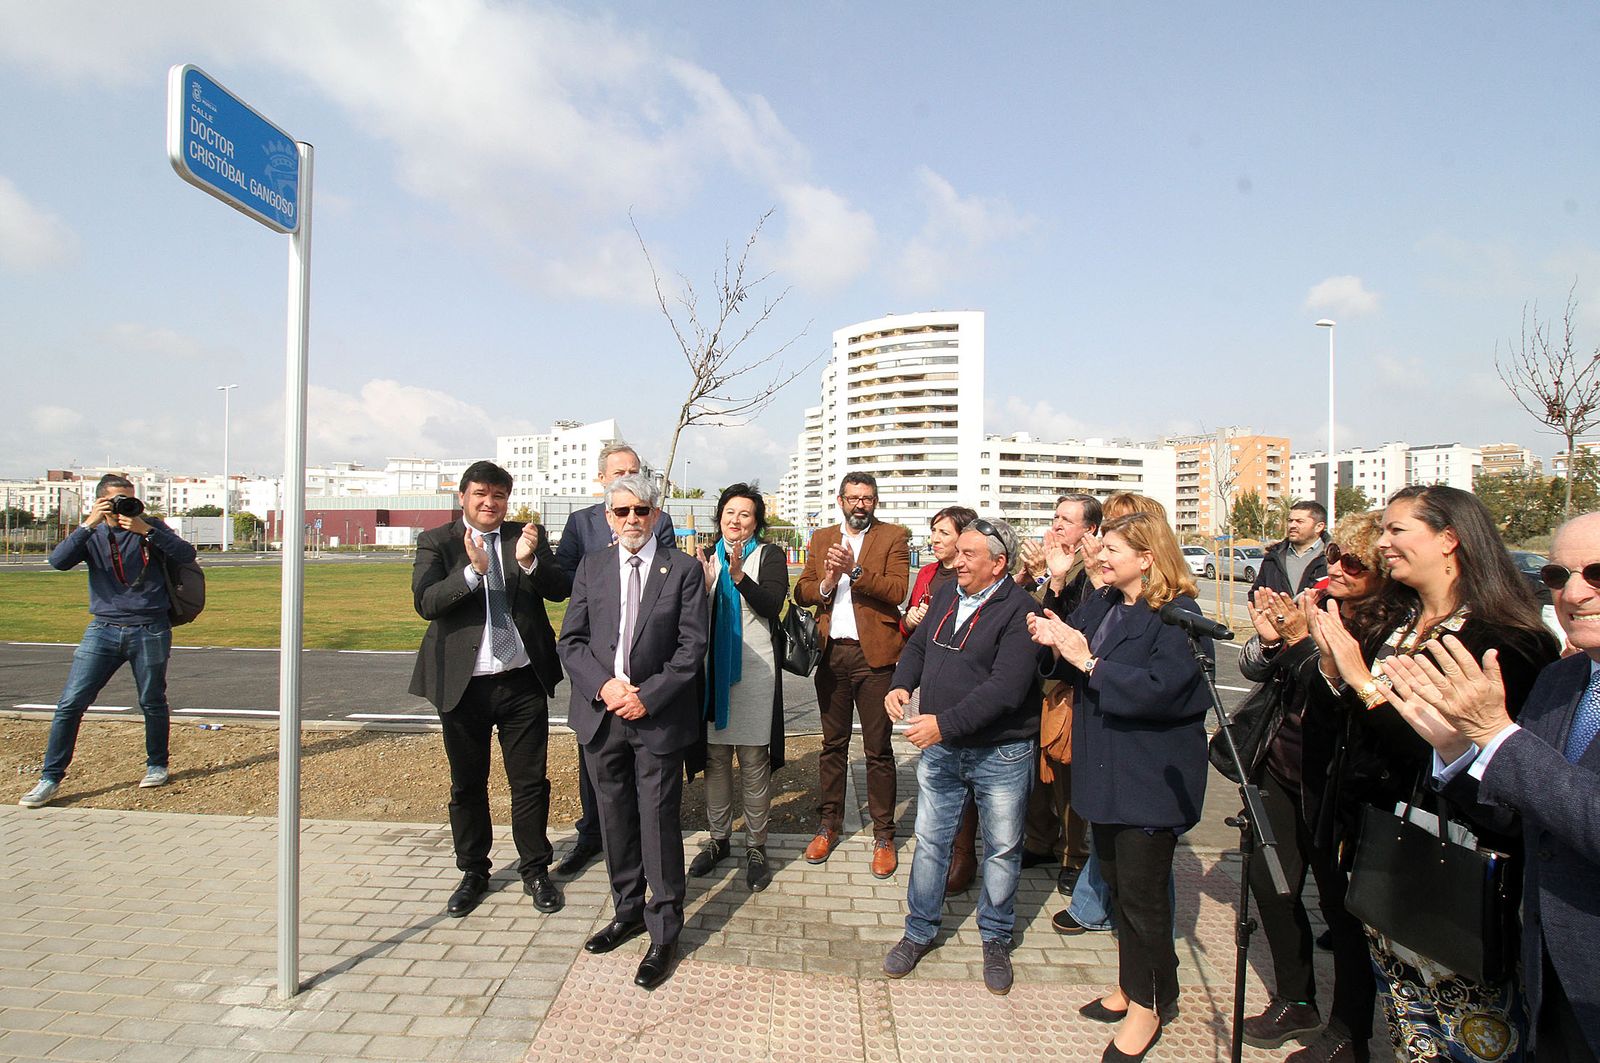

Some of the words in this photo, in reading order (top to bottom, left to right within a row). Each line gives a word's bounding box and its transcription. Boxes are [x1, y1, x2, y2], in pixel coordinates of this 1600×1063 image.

[191, 103, 213, 124] CALLE
[190, 116, 234, 159] DOCTOR
[189, 140, 248, 190] CRISTÓBAL
[250, 178, 294, 218] GANGOSO
